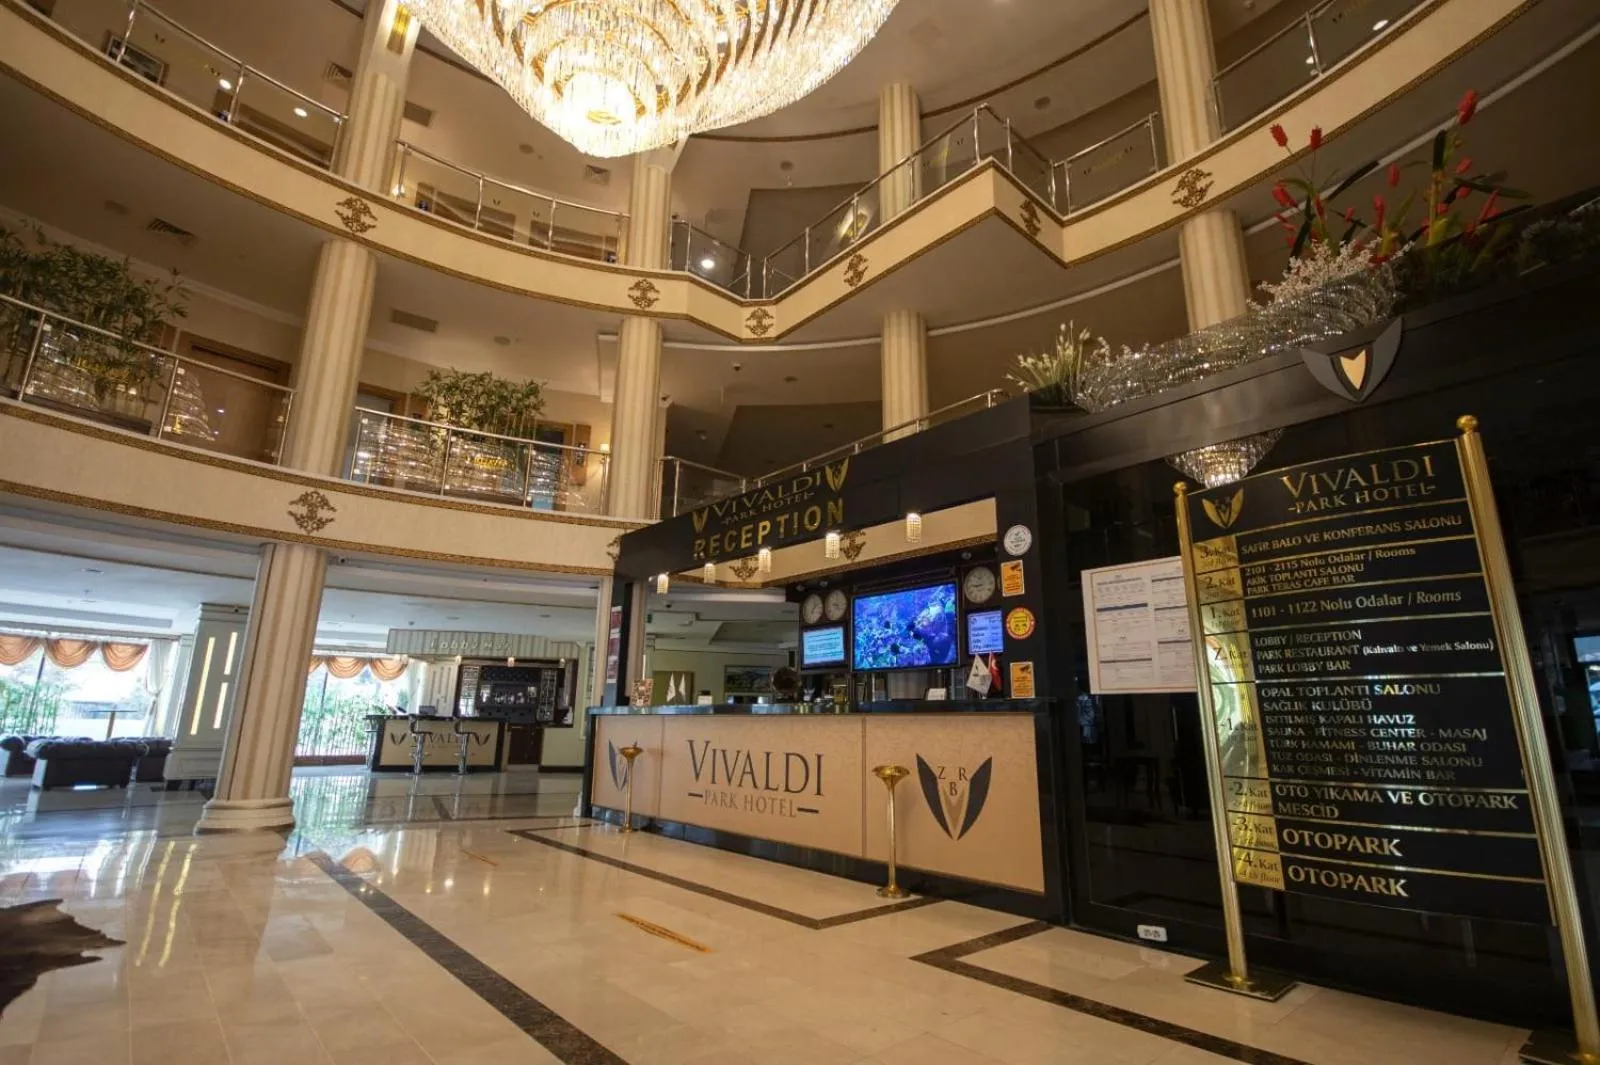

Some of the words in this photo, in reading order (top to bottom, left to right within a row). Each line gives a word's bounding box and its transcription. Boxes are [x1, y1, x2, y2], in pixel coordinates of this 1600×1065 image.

[1280, 454, 1436, 499] VIVALDI
[712, 471, 822, 517] VIVALDI
[693, 497, 843, 560] RECEPTION
[1272, 531, 1302, 549] BALO
[1304, 532, 1320, 543] VE
[1323, 522, 1401, 541] KONFERANS
[1405, 515, 1462, 531] SALONU
[1328, 551, 1365, 563] Odalar
[1375, 547, 1416, 559] Rooms
[1320, 564, 1364, 576] SALONU
[1289, 601, 1317, 615] 1122
[1320, 598, 1352, 612] Nolu
[1355, 593, 1404, 609] Odalar
[1416, 590, 1462, 604] Rooms
[1255, 635, 1288, 647] LOBBY
[1297, 629, 1362, 644] RECEPTION
[1256, 649, 1283, 661] PARK
[1284, 644, 1360, 659] RESTAURANT
[1454, 638, 1494, 651] Salonu)
[1258, 662, 1285, 674] PARK
[1287, 660, 1324, 672] LOBBY
[1326, 660, 1351, 670] BAR
[1261, 687, 1295, 698] OPAL
[1297, 685, 1370, 698] TOPLANTI
[1373, 684, 1441, 696] SALONU
[1311, 698, 1373, 713] KULÜBÜ
[1367, 714, 1416, 726] HAVUZ
[1369, 728, 1426, 739] CENTER
[1439, 728, 1488, 741] MASAJ
[1367, 740, 1416, 752] BUHAR
[1419, 742, 1466, 754] ODASI
[1344, 751, 1418, 766] DİNLENME
[1421, 756, 1483, 767] SALONU
[687, 739, 824, 797] VIVALDI
[938, 765, 946, 780] Z
[958, 766, 968, 781] R
[1426, 769, 1457, 781] BAR
[949, 781, 958, 794] B
[704, 792, 737, 809] PARK
[743, 795, 797, 818] HOTEL
[1275, 784, 1309, 798] OTO
[1313, 788, 1382, 803] YIKAMA
[1386, 789, 1413, 805] VE
[1419, 792, 1518, 810] OTOPARK
[1283, 828, 1403, 857] OTOPARK
[1287, 866, 1409, 897] OTOPARK
